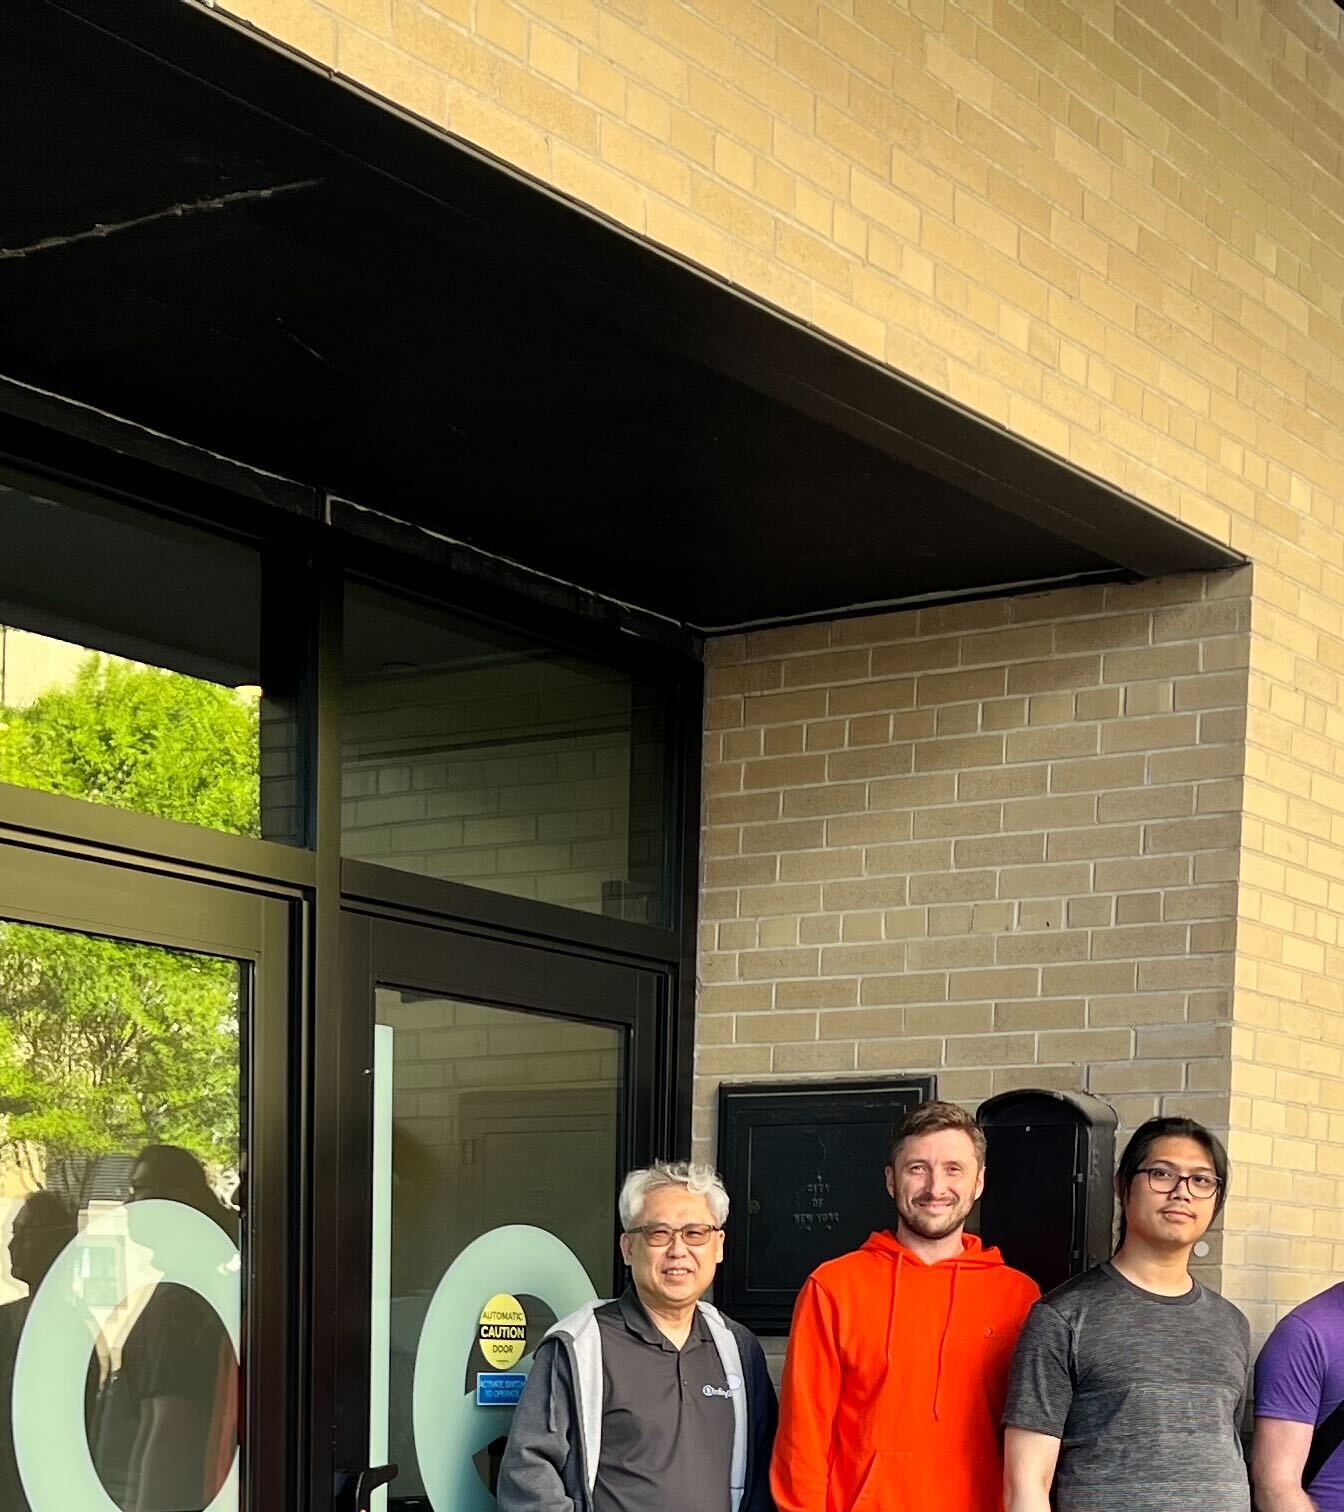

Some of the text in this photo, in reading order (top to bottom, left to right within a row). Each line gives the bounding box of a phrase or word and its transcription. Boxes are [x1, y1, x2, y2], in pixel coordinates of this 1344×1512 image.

[483, 1311, 523, 1321] AUTOMATIC
[480, 1326, 524, 1338] CAUTION
[492, 1344, 513, 1354] DOOR
